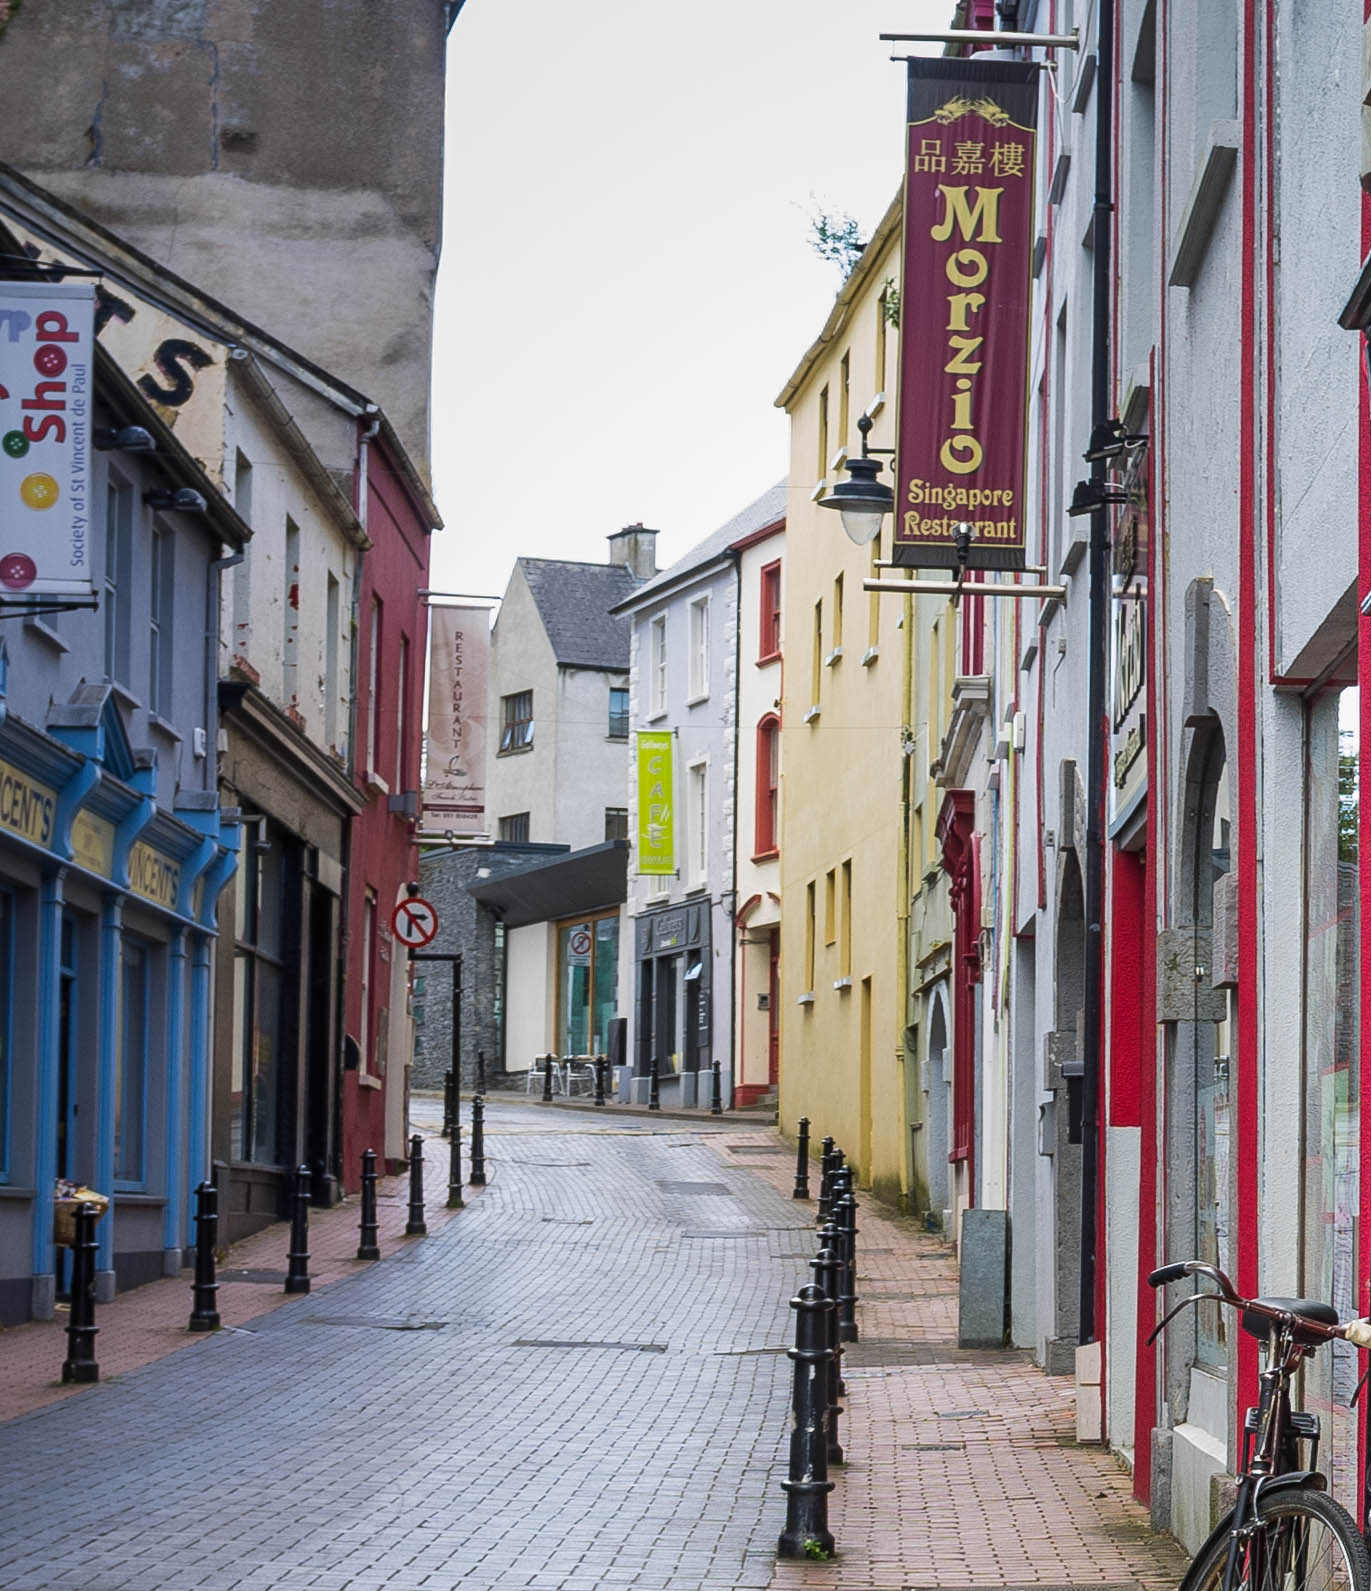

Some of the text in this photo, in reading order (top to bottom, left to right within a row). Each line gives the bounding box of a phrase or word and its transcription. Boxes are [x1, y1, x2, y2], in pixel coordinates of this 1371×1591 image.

[914, 139, 1025, 177] 品嘉樓
[21, 310, 80, 444] Shop
[930, 184, 1005, 475] Morzio
[70, 363, 88, 567] Society of St Vincent de Paul
[907, 479, 1014, 511] Singapore
[903, 511, 1017, 539] Restrant
[452, 631, 464, 749] RESTAURANT
